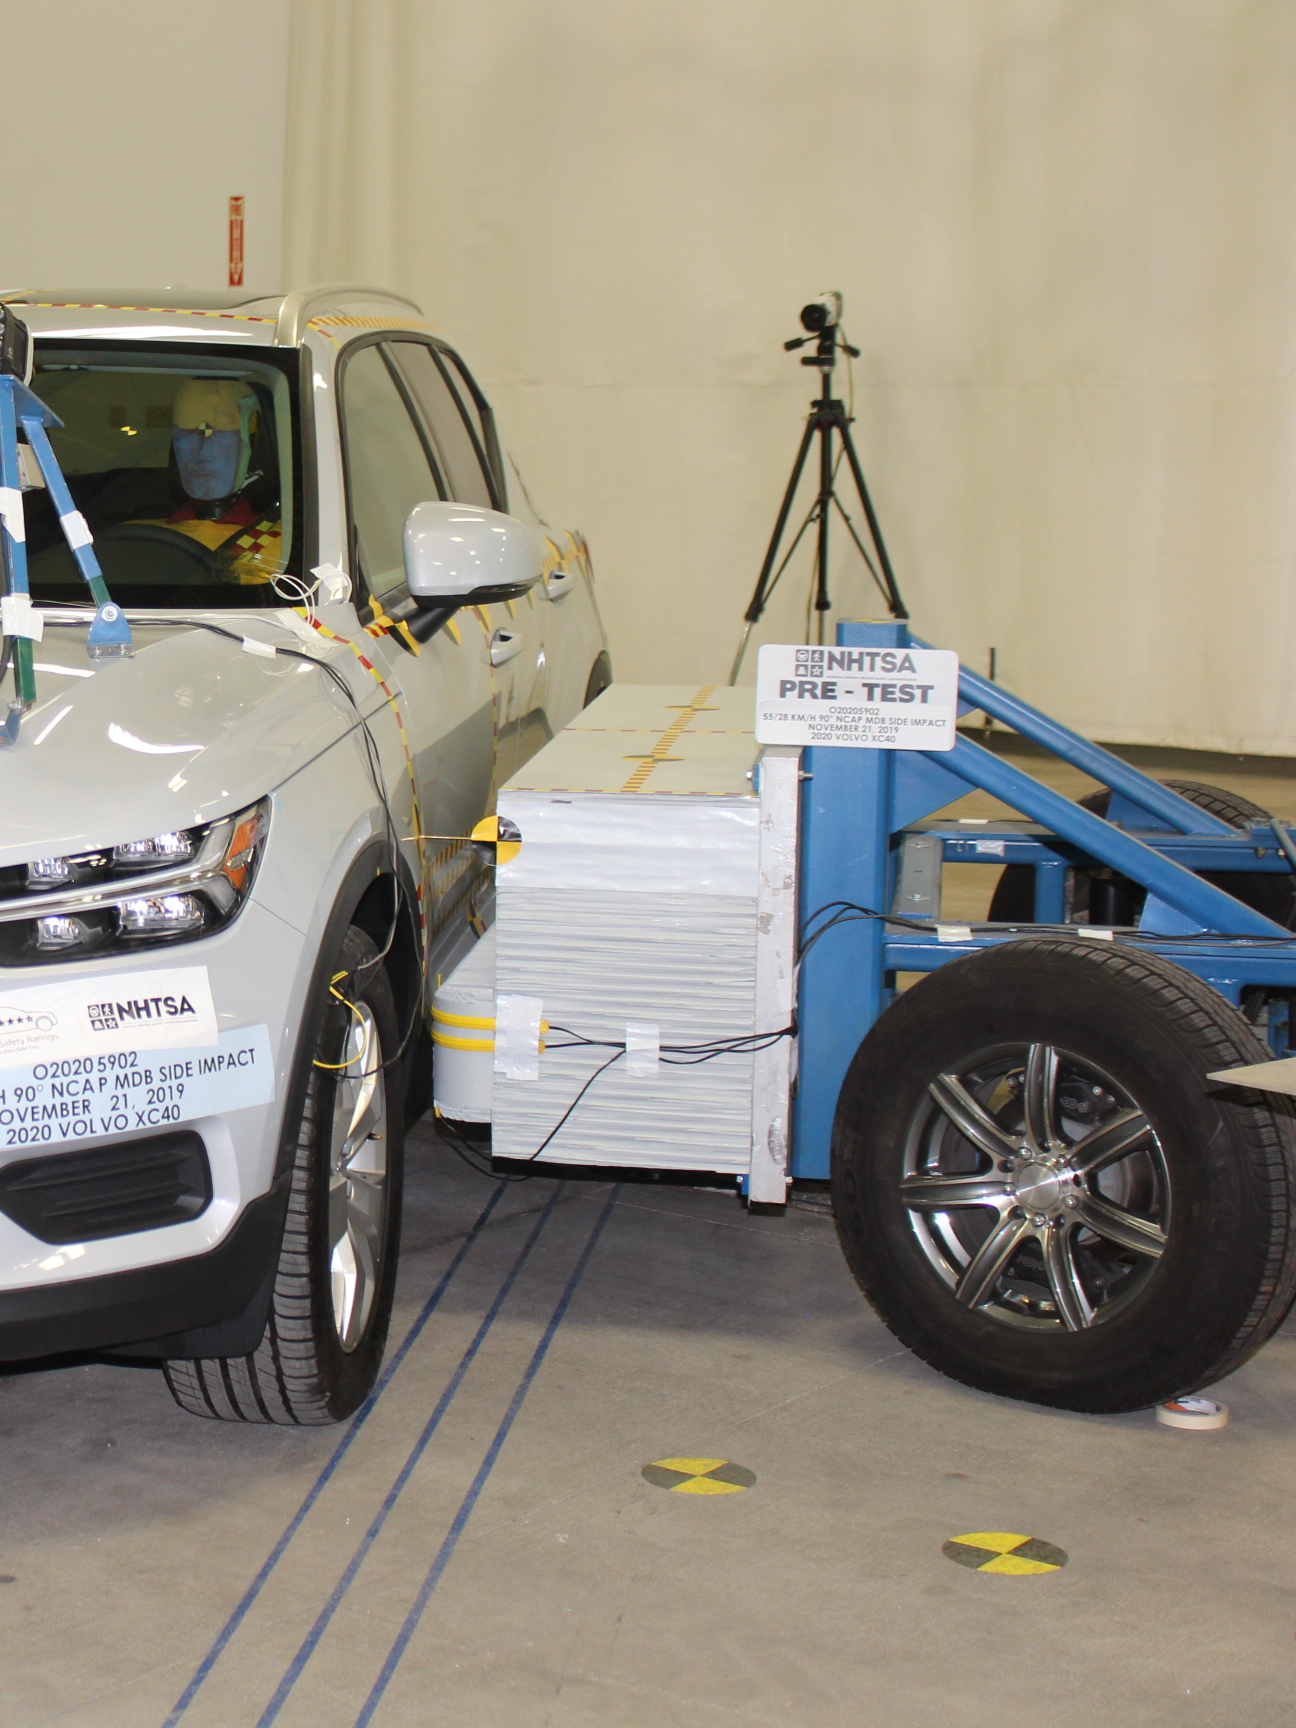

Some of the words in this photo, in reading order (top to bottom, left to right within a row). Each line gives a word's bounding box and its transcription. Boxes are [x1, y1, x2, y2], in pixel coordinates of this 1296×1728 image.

[827, 650, 917, 674] NHTSA
[779, 679, 837, 700] PRE
[862, 682, 934, 704] TEST
[763, 713, 788, 721] 55/28
[791, 714, 816, 722] KM/H
[836, 715, 862, 724] NCAP
[865, 716, 886, 725] MDB
[888, 717, 908, 726] SIDE
[911, 718, 946, 727] IMPACT
[808, 723, 859, 733] NOVEMBER
[878, 726, 899, 734] 2019
[811, 732, 832, 740] 2020
[835, 733, 868, 742] VOLVO
[871, 735, 896, 743] XC40
[116, 995, 196, 1021] NHTSA
[27, 1034, 58, 1043] Ratings
[14, 1085, 44, 1103] 90°
[51, 1077, 108, 1099] NCAP
[115, 1069, 153, 1091] MDB
[159, 1061, 193, 1082] SIDE
[198, 1048, 255, 1075] IMPACT
[110, 1093, 135, 1111] 21,
[147, 1083, 185, 1105] 2019
[6, 1124, 52, 1145] 2020
[59, 1114, 128, 1138] VOLVO
[135, 1104, 181, 1128] XC40
